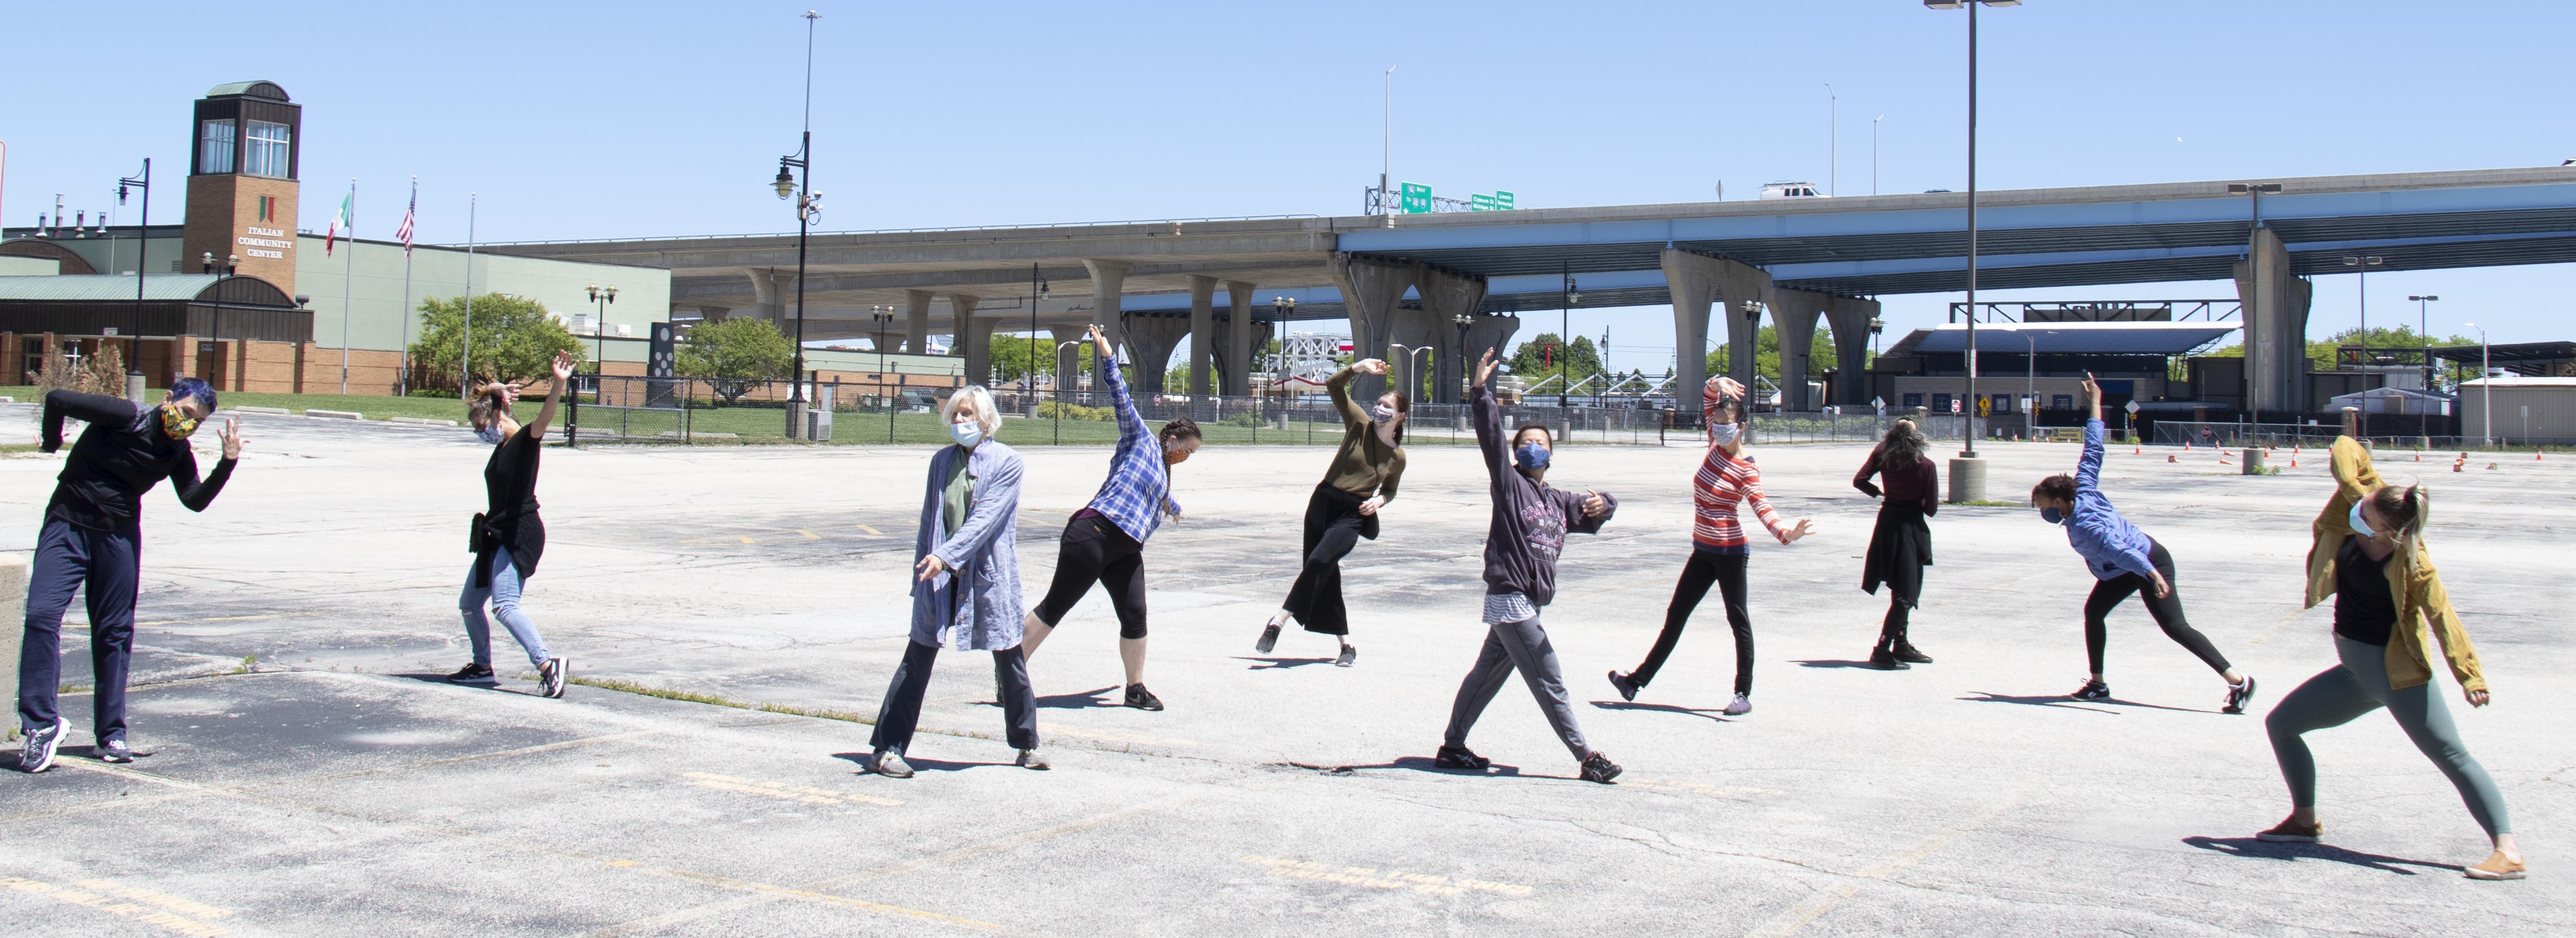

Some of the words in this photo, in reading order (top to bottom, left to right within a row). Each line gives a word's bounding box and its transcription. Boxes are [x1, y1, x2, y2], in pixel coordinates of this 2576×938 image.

[248, 227, 284, 236] ITALIAN
[238, 237, 292, 249] COMMUNITY
[247, 249, 282, 259] CENTER
